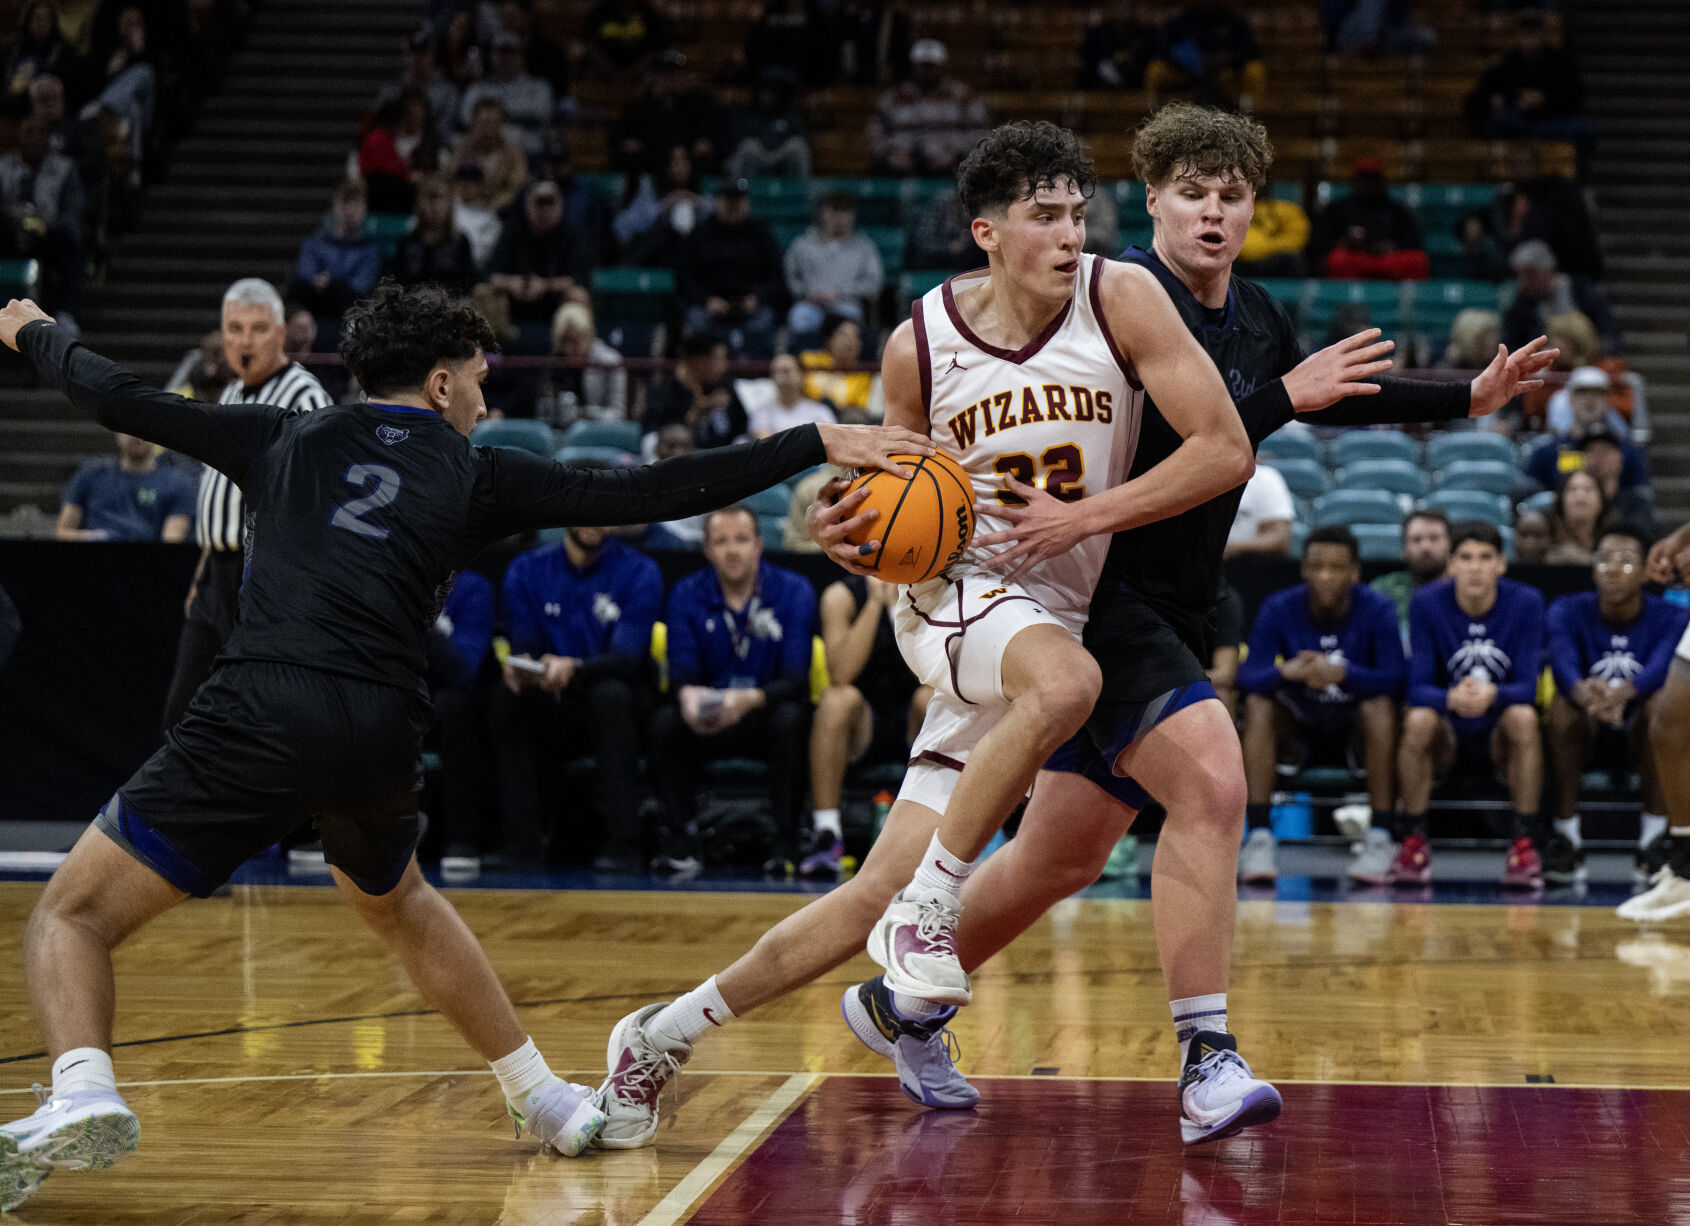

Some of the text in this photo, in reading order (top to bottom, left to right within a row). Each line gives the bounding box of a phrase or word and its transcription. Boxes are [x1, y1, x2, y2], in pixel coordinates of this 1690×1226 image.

[948, 384, 1113, 450] WIZARDS
[328, 462, 402, 540] 2
[992, 441, 1086, 507] 32
